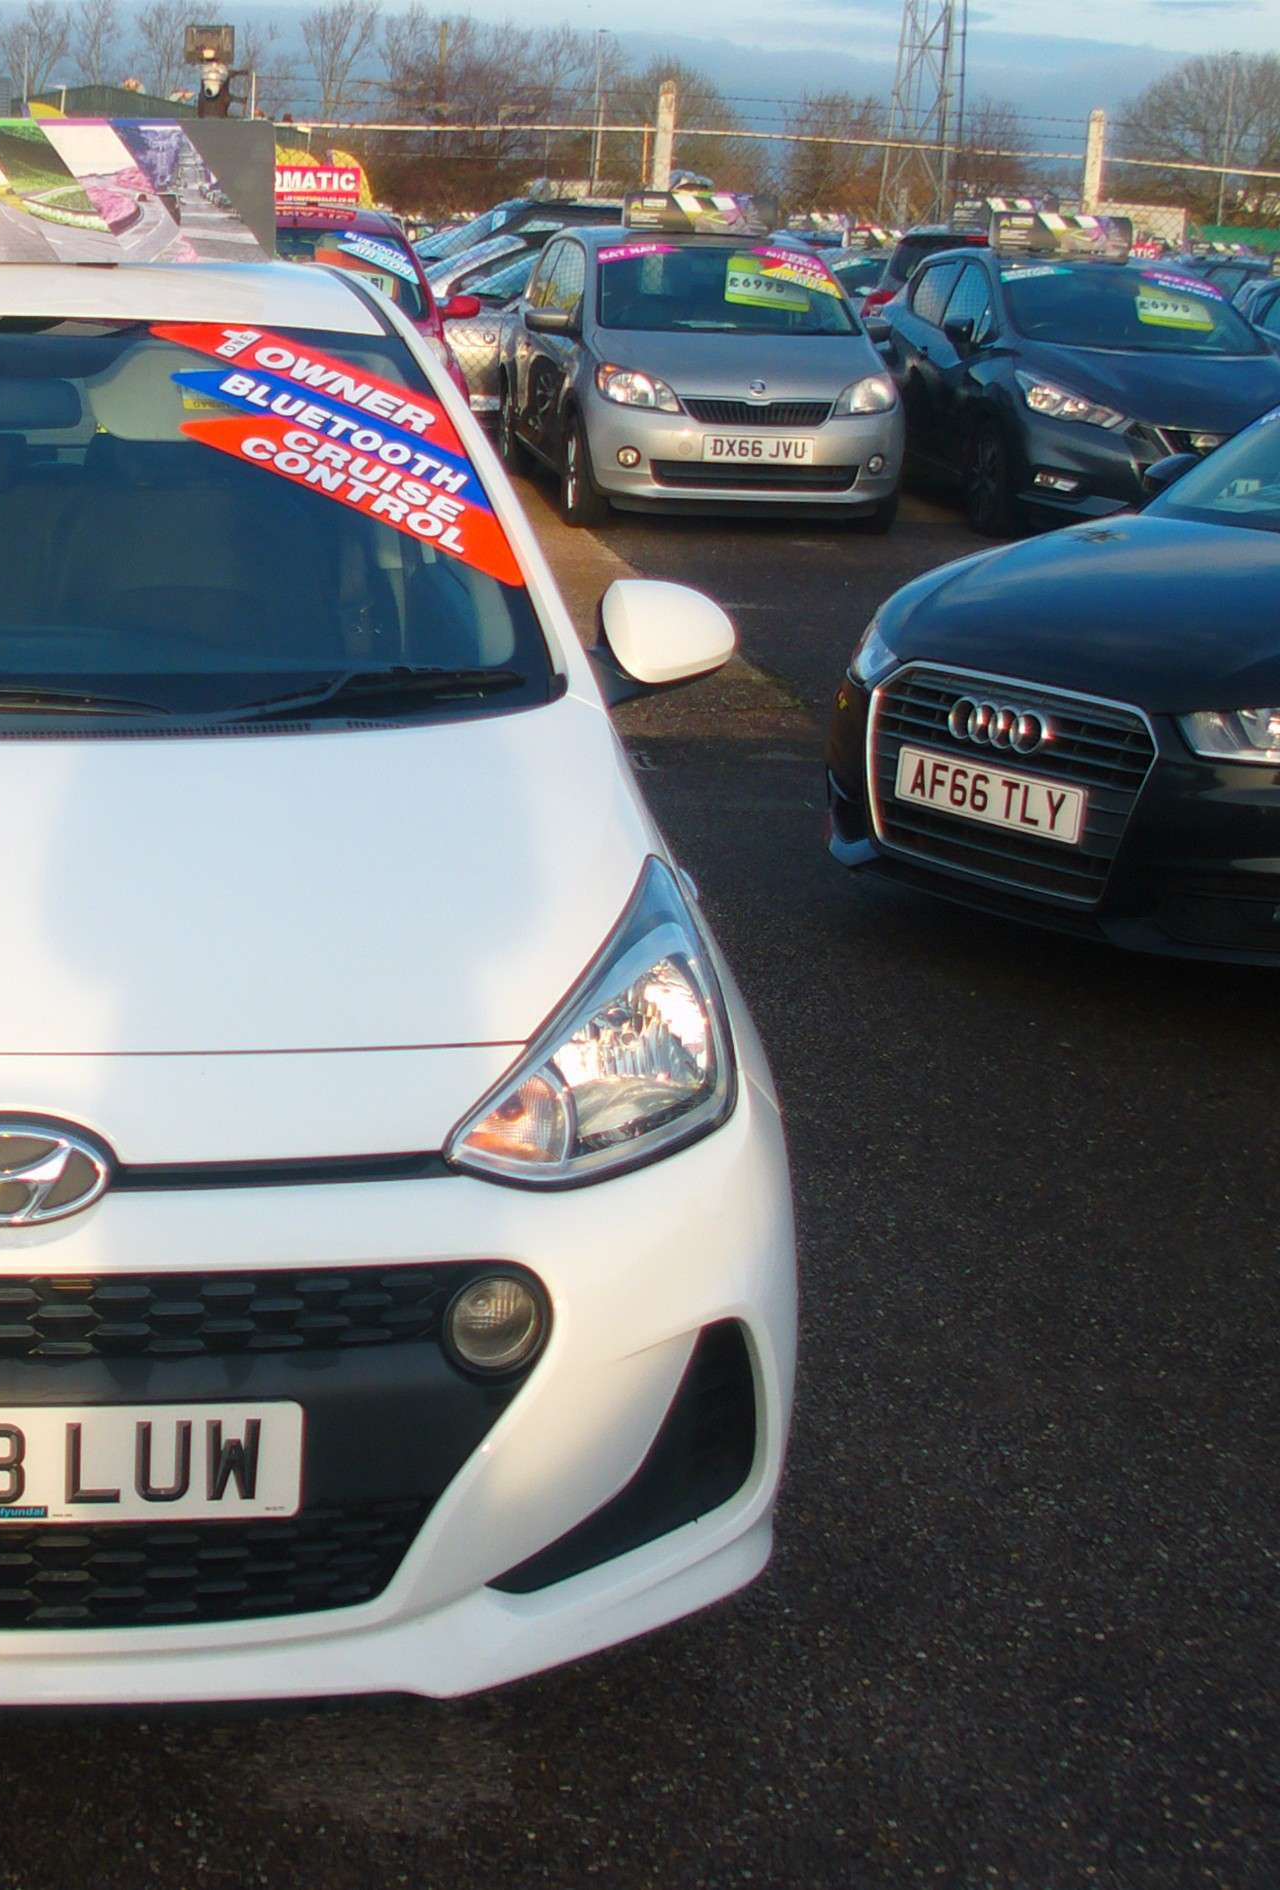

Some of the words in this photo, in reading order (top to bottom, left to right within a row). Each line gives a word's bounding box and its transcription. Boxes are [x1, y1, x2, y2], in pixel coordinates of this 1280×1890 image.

[344, 231, 408, 262] BLUETOOTH
[351, 243, 377, 260] AIR
[379, 254, 412, 276] CON
[214, 329, 263, 358] 1
[255, 346, 436, 434] OWNER
[219, 373, 469, 494] BLUETOOTH
[282, 429, 466, 524] CRUISE
[712, 438, 763, 457] DX66
[768, 440, 806, 459] JVU
[240, 436, 466, 555] CONTROL
[910, 759, 989, 812] AF66
[1000, 779, 1067, 830] TLY
[65, 1418, 262, 1504] LUW
